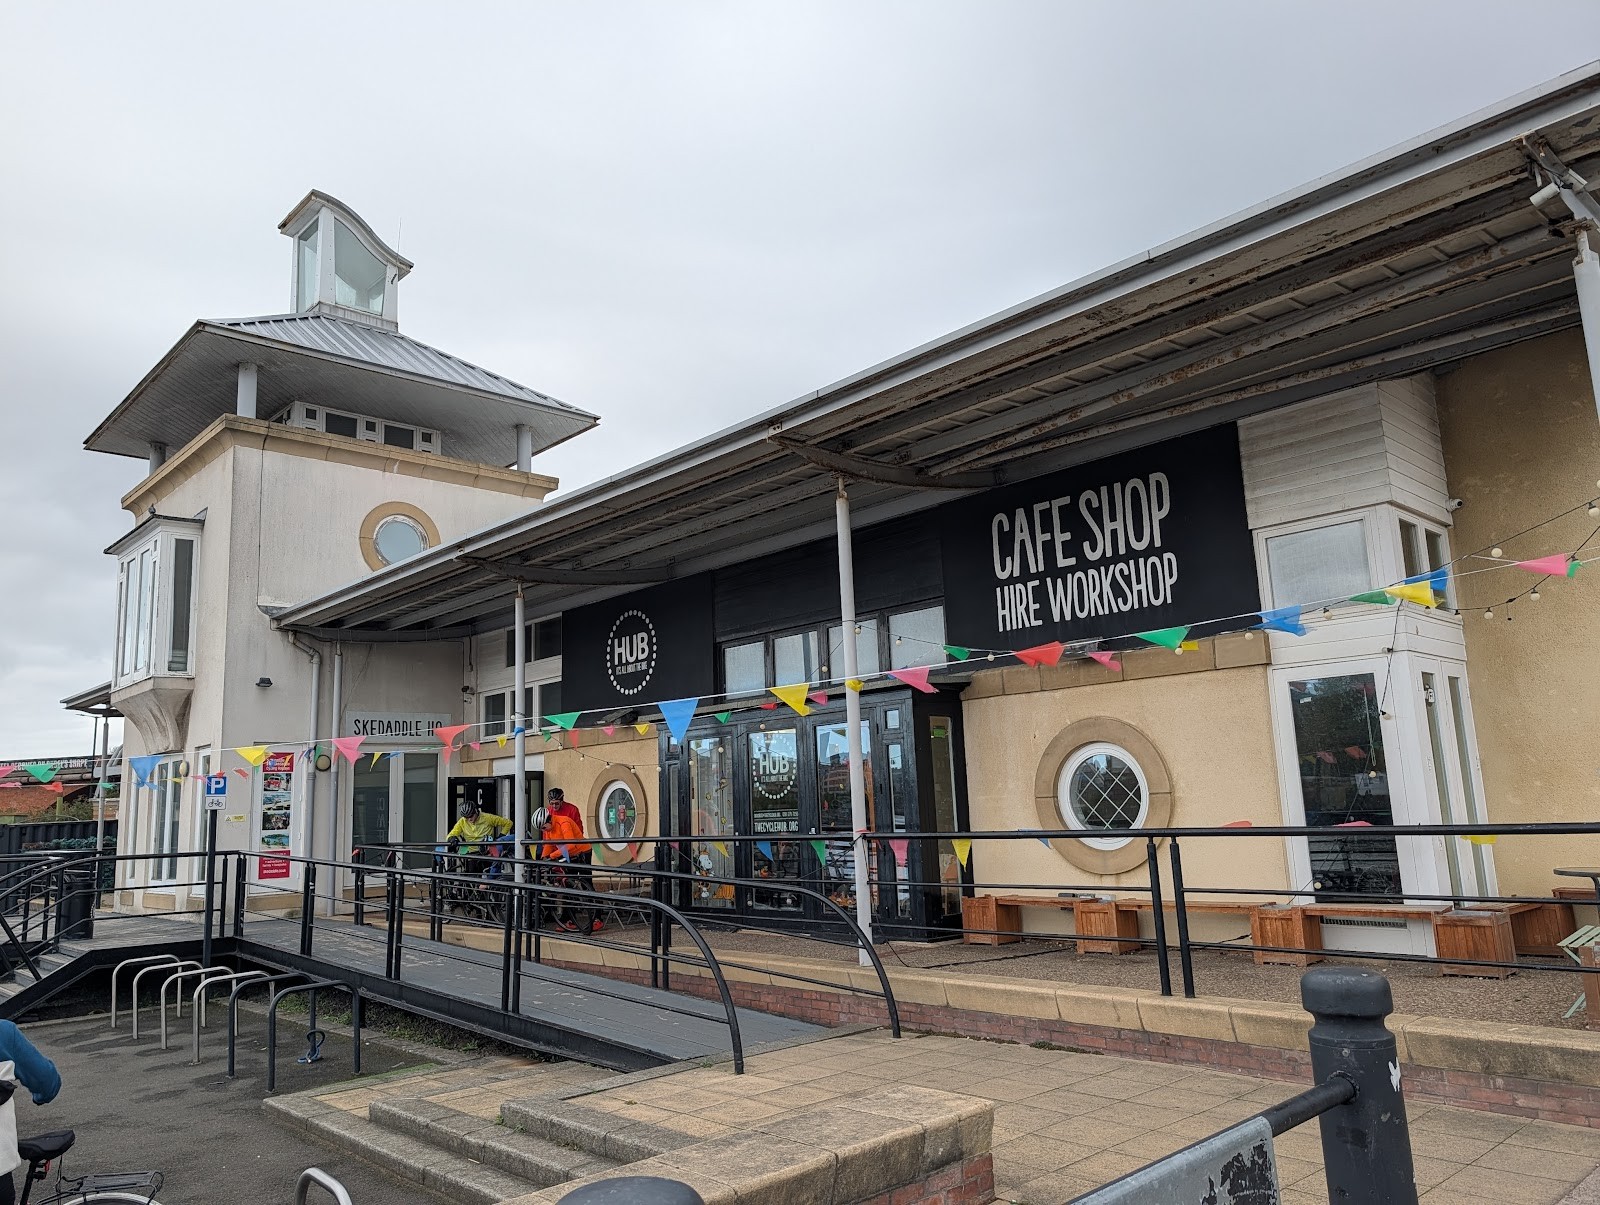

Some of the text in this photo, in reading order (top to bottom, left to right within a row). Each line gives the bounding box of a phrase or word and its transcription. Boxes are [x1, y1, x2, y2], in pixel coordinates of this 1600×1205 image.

[992, 471, 1171, 580] CAFE SHOP
[996, 552, 1178, 633] HIRE WORKSHOP
[614, 631, 649, 666] HUB
[353, 718, 422, 737] SKEDADDLE
[759, 751, 790, 775] HUB
[210, 777, 225, 794] P
